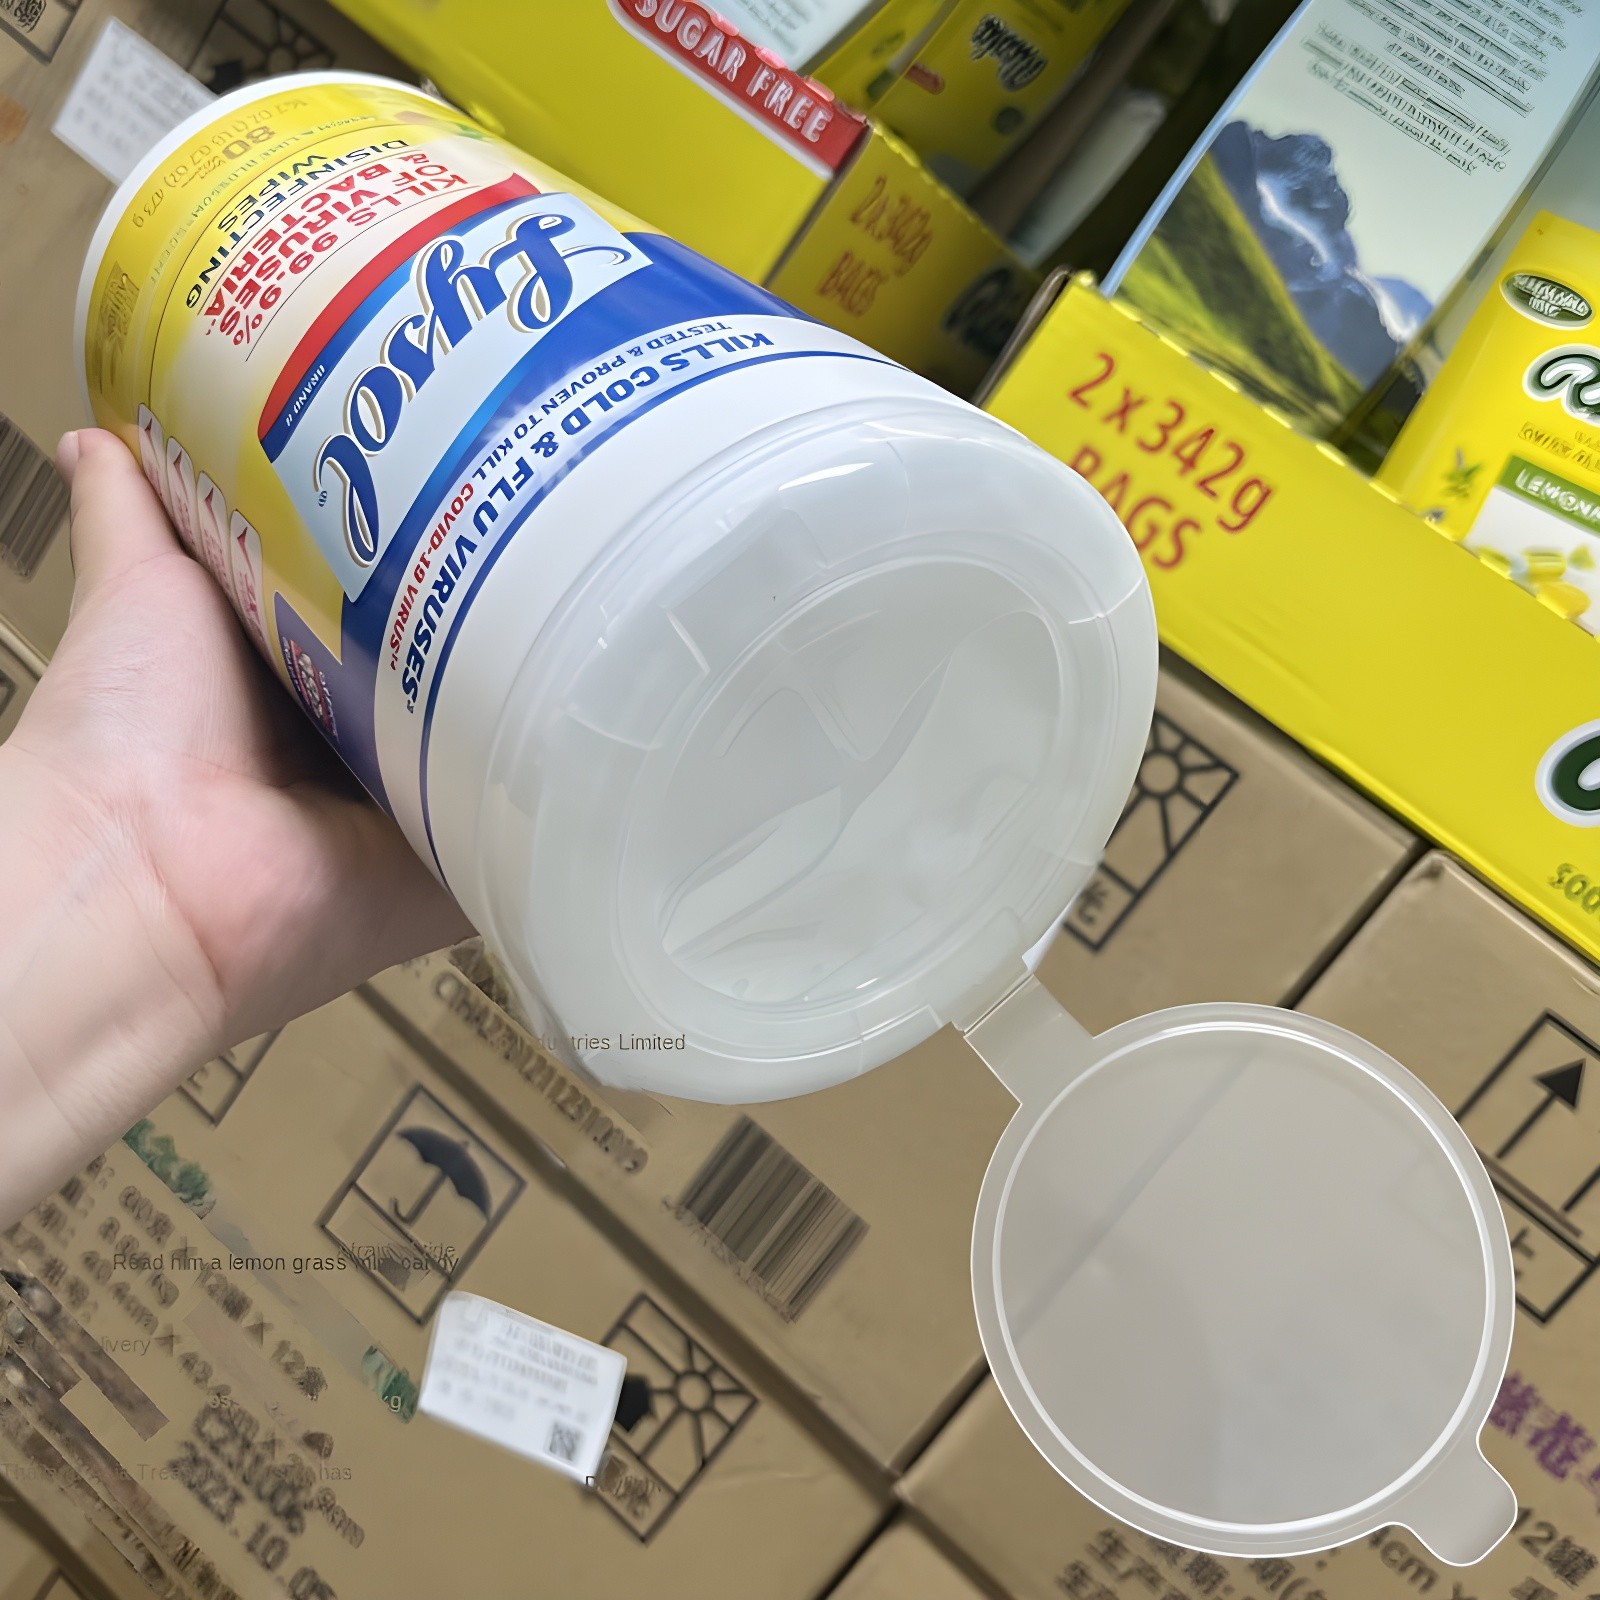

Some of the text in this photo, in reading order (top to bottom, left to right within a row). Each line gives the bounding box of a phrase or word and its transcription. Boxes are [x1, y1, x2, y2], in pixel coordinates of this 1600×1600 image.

[634, 0, 748, 81] SUGAR
[746, 61, 834, 143] FREE
[222, 125, 276, 160] 80
[217, 154, 329, 232] WIPES
[346, 174, 469, 227] KILLS
[392, 164, 449, 187] OF
[186, 139, 410, 309] DISINFECTING
[218, 189, 380, 336] VIRUSES
[232, 231, 339, 346] 99.9%
[627, 345, 644, 356] &
[646, 320, 733, 350] TESTED
[659, 332, 775, 372] KILLS
[312, 212, 632, 569] Lysol
[541, 354, 627, 416] PROVEN
[560, 365, 661, 436] COLD
[513, 414, 543, 440] TO
[530, 430, 559, 459] &
[471, 437, 514, 481] KILL
[472, 456, 535, 538] FLU
[413, 482, 475, 585] COVID-19
